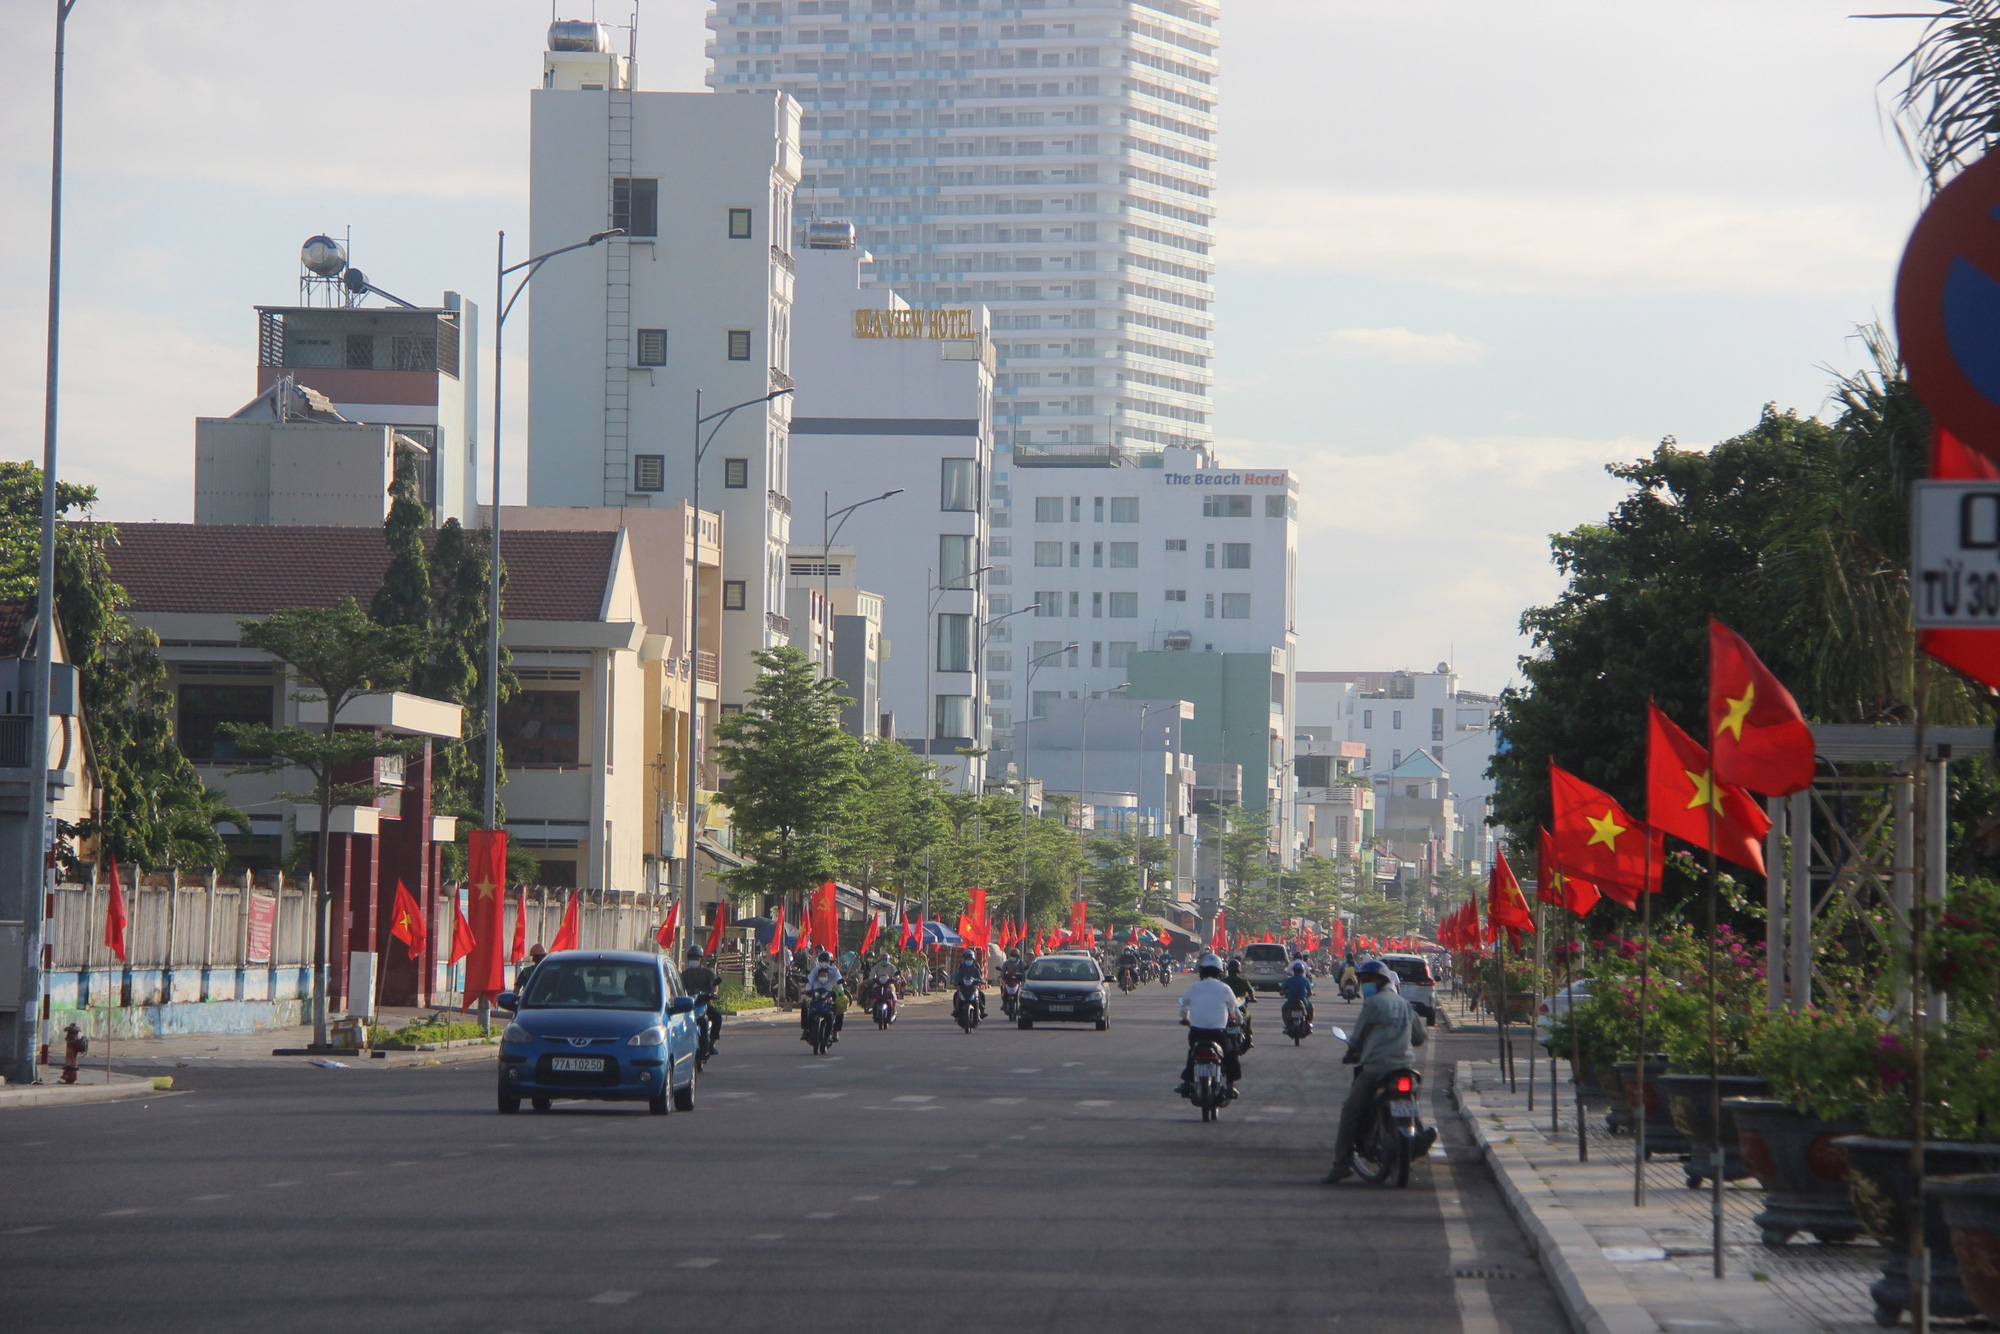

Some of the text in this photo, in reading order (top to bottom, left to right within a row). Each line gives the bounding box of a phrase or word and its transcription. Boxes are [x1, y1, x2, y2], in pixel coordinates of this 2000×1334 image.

[855, 309, 976, 338] SEA VIEW HOTEL
[1164, 473, 1191, 485] The
[1194, 473, 1240, 485] Beach
[1244, 473, 1286, 486] Hotel
